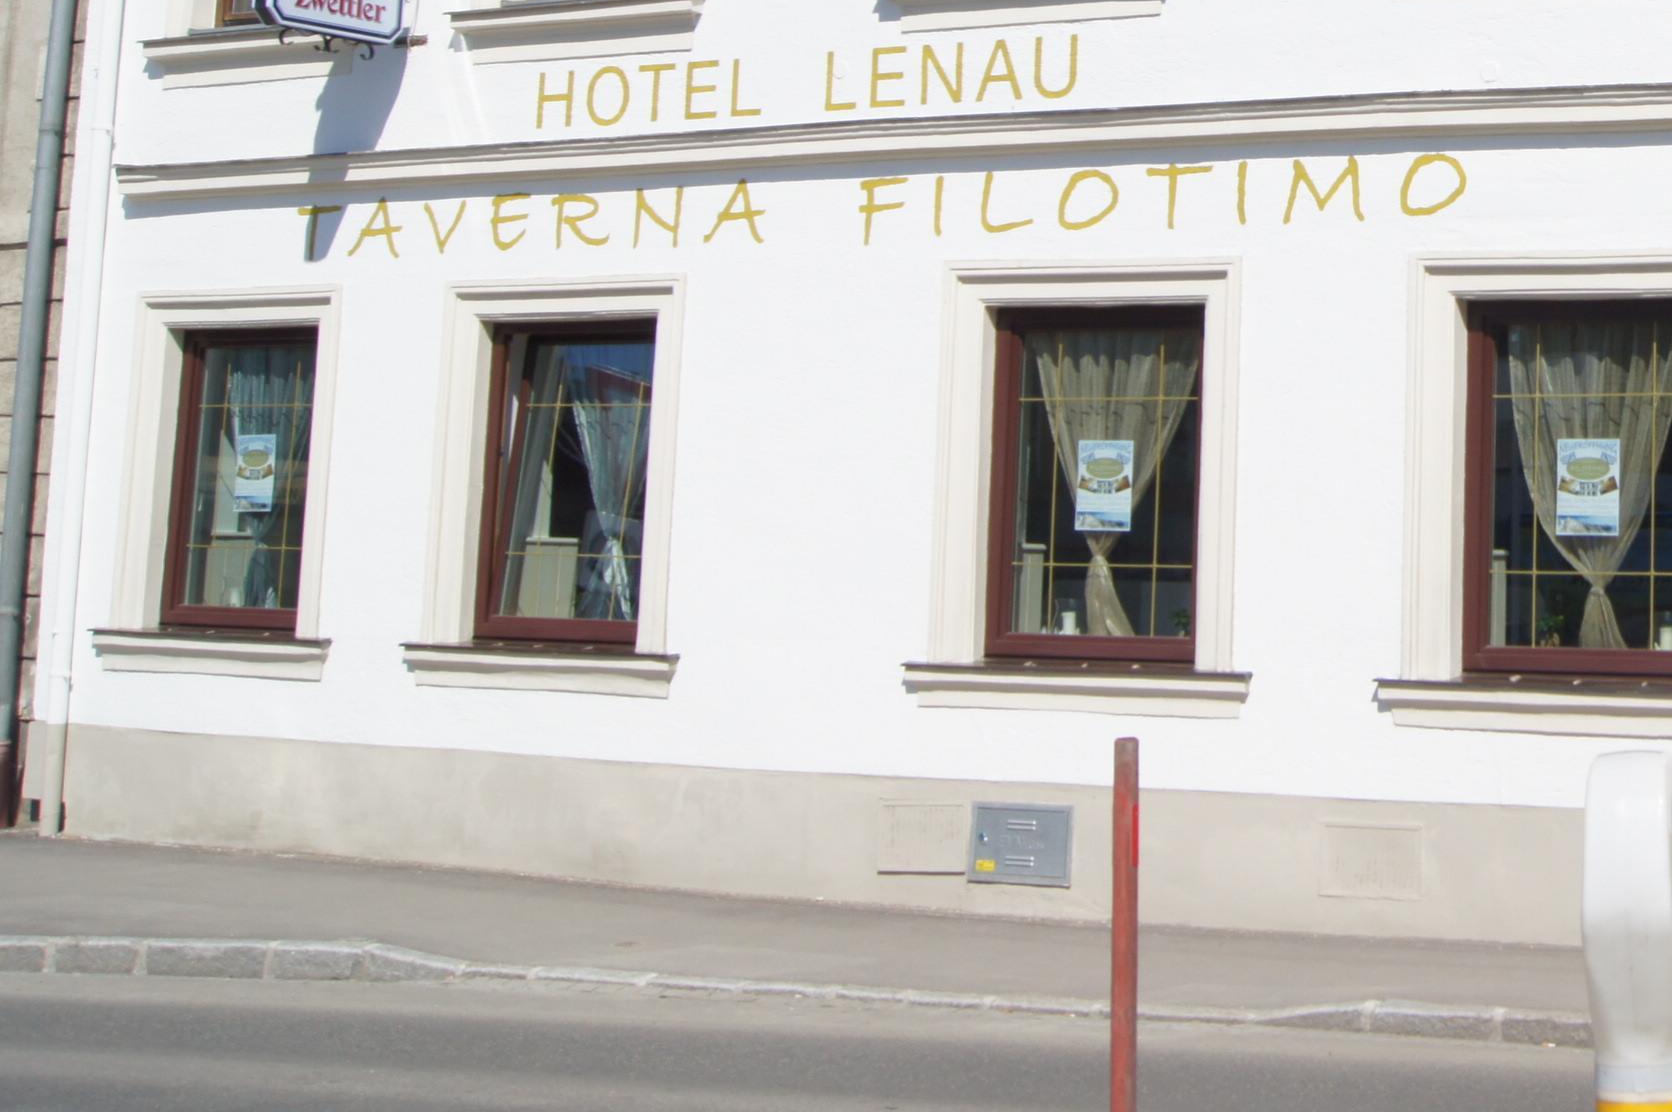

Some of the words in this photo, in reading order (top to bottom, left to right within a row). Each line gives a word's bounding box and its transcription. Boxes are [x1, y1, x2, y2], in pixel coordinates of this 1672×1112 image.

[536, 58, 762, 129] HOTEL
[823, 33, 1080, 112] LENAU
[297, 178, 767, 263] TAVERNA
[859, 152, 1468, 247] FILOTIMO
